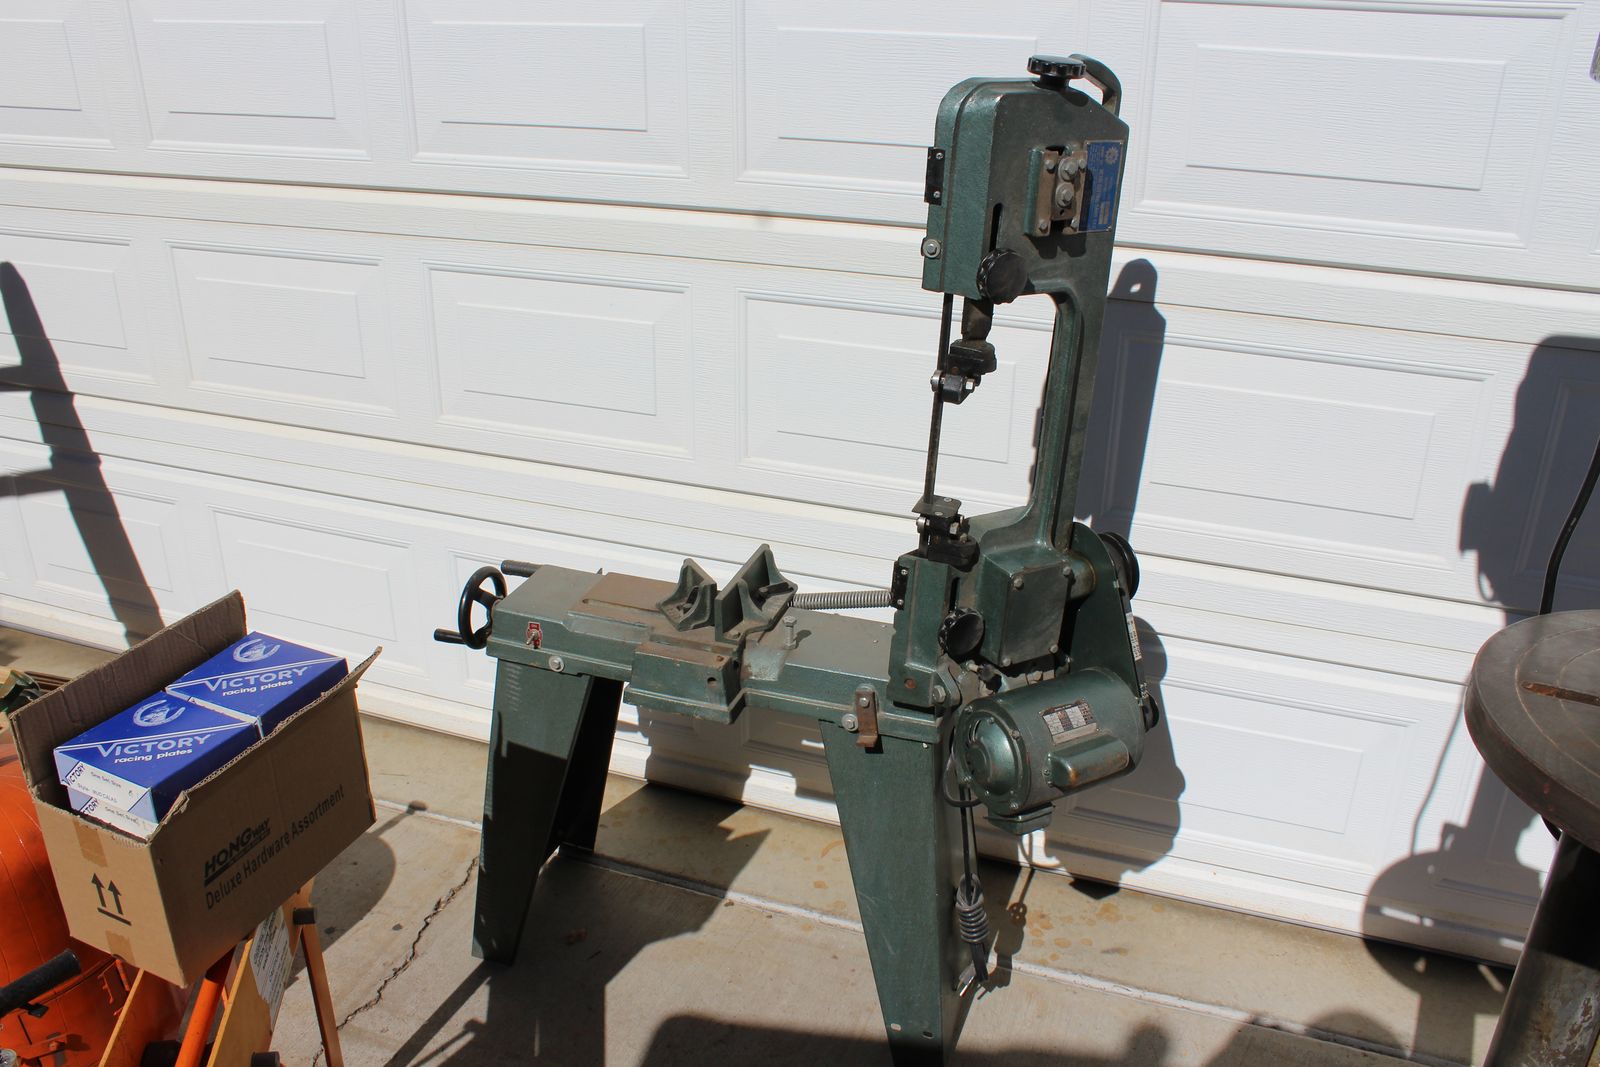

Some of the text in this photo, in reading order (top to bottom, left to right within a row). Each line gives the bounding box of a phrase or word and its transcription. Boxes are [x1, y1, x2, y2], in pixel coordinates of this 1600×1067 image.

[204, 666, 308, 691] VICTORY
[222, 680, 293, 697] racing plates
[97, 734, 211, 757] VICTORY
[114, 748, 193, 764] racing plates
[61, 763, 86, 786] VICTORY
[83, 798, 100, 815] CTORY
[205, 784, 345, 910] Deluxe Hardware Assortment
